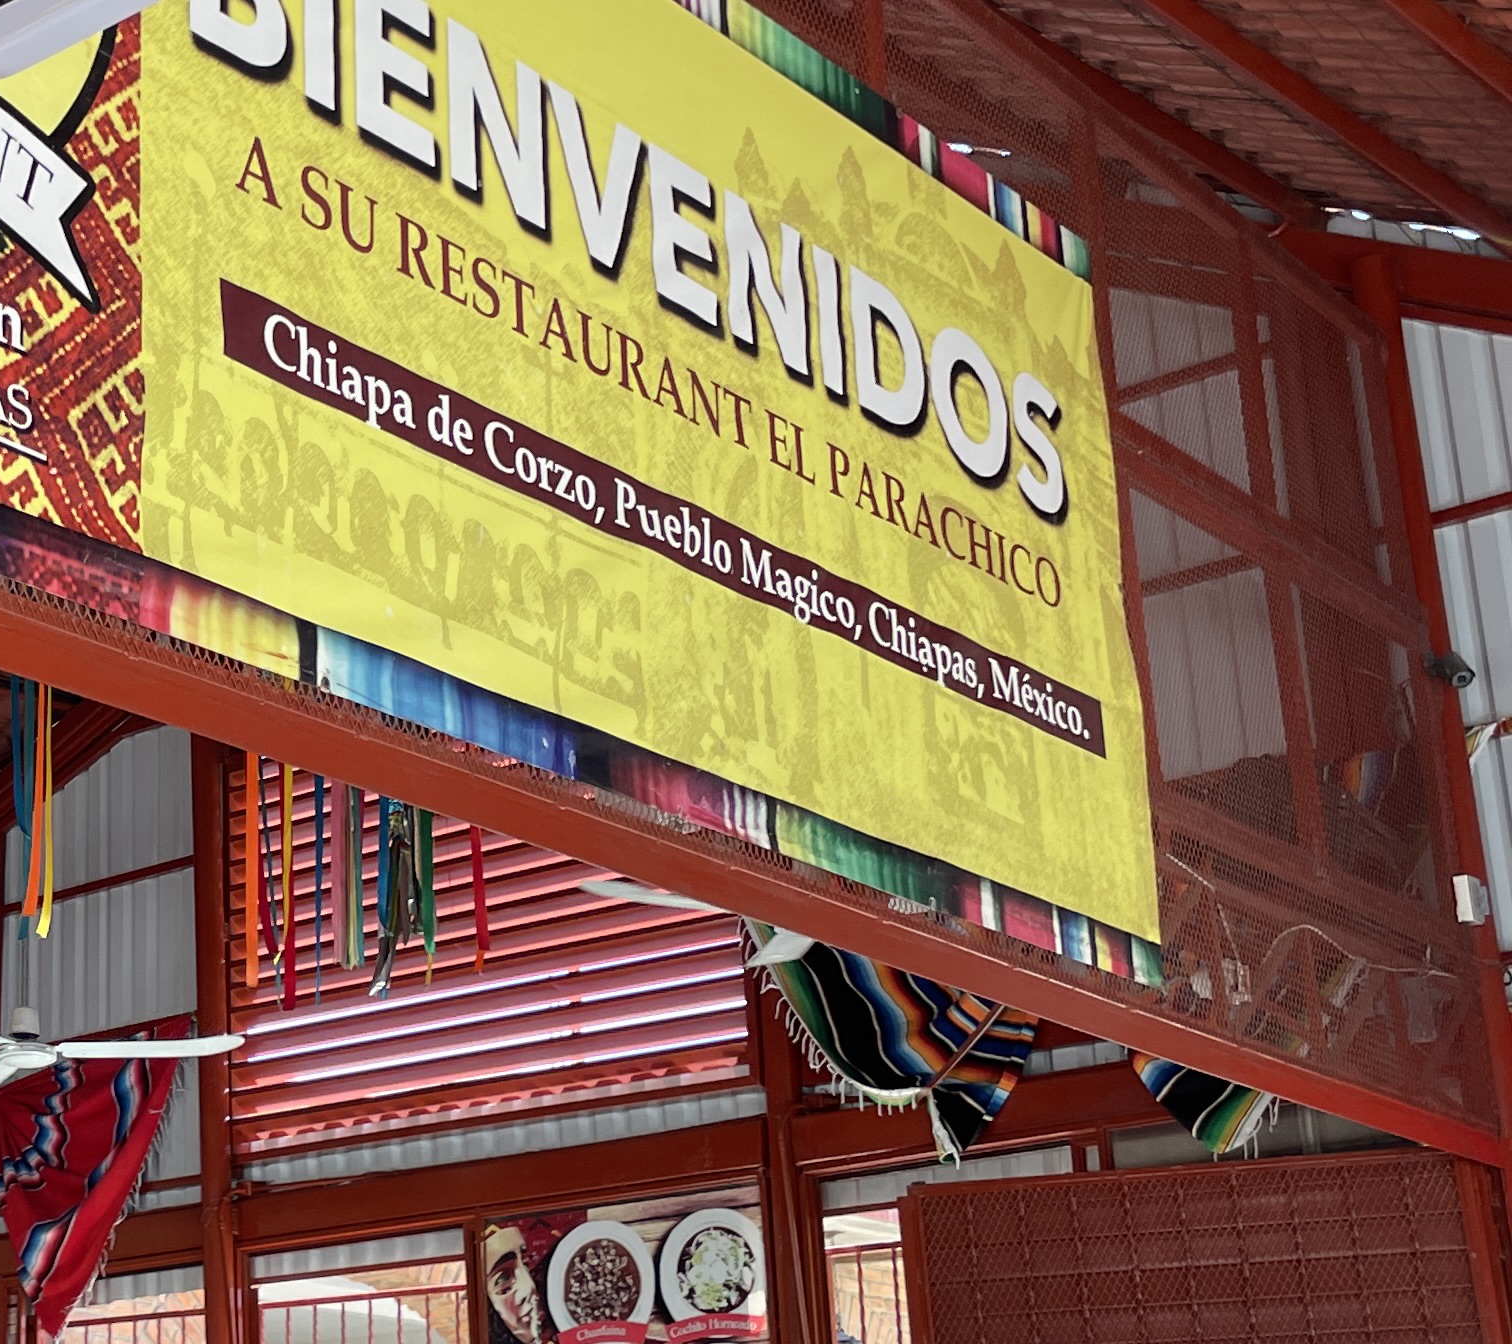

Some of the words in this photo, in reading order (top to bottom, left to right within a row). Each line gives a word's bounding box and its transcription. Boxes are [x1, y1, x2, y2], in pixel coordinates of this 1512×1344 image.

[235, 135, 282, 209] A
[300, 166, 378, 254] SU
[396, 211, 753, 452] RESTAURANT
[766, 407, 817, 489] EL
[827, 443, 1063, 609] PARACHICO
[261, 313, 417, 432] Chiapa
[425, 393, 474, 465] de
[484, 422, 607, 525] Corzo,
[614, 478, 733, 574] Pueblo
[739, 539, 864, 639] Magico,
[866, 601, 985, 699] Chiapas,
[990, 655, 1092, 742] México.
